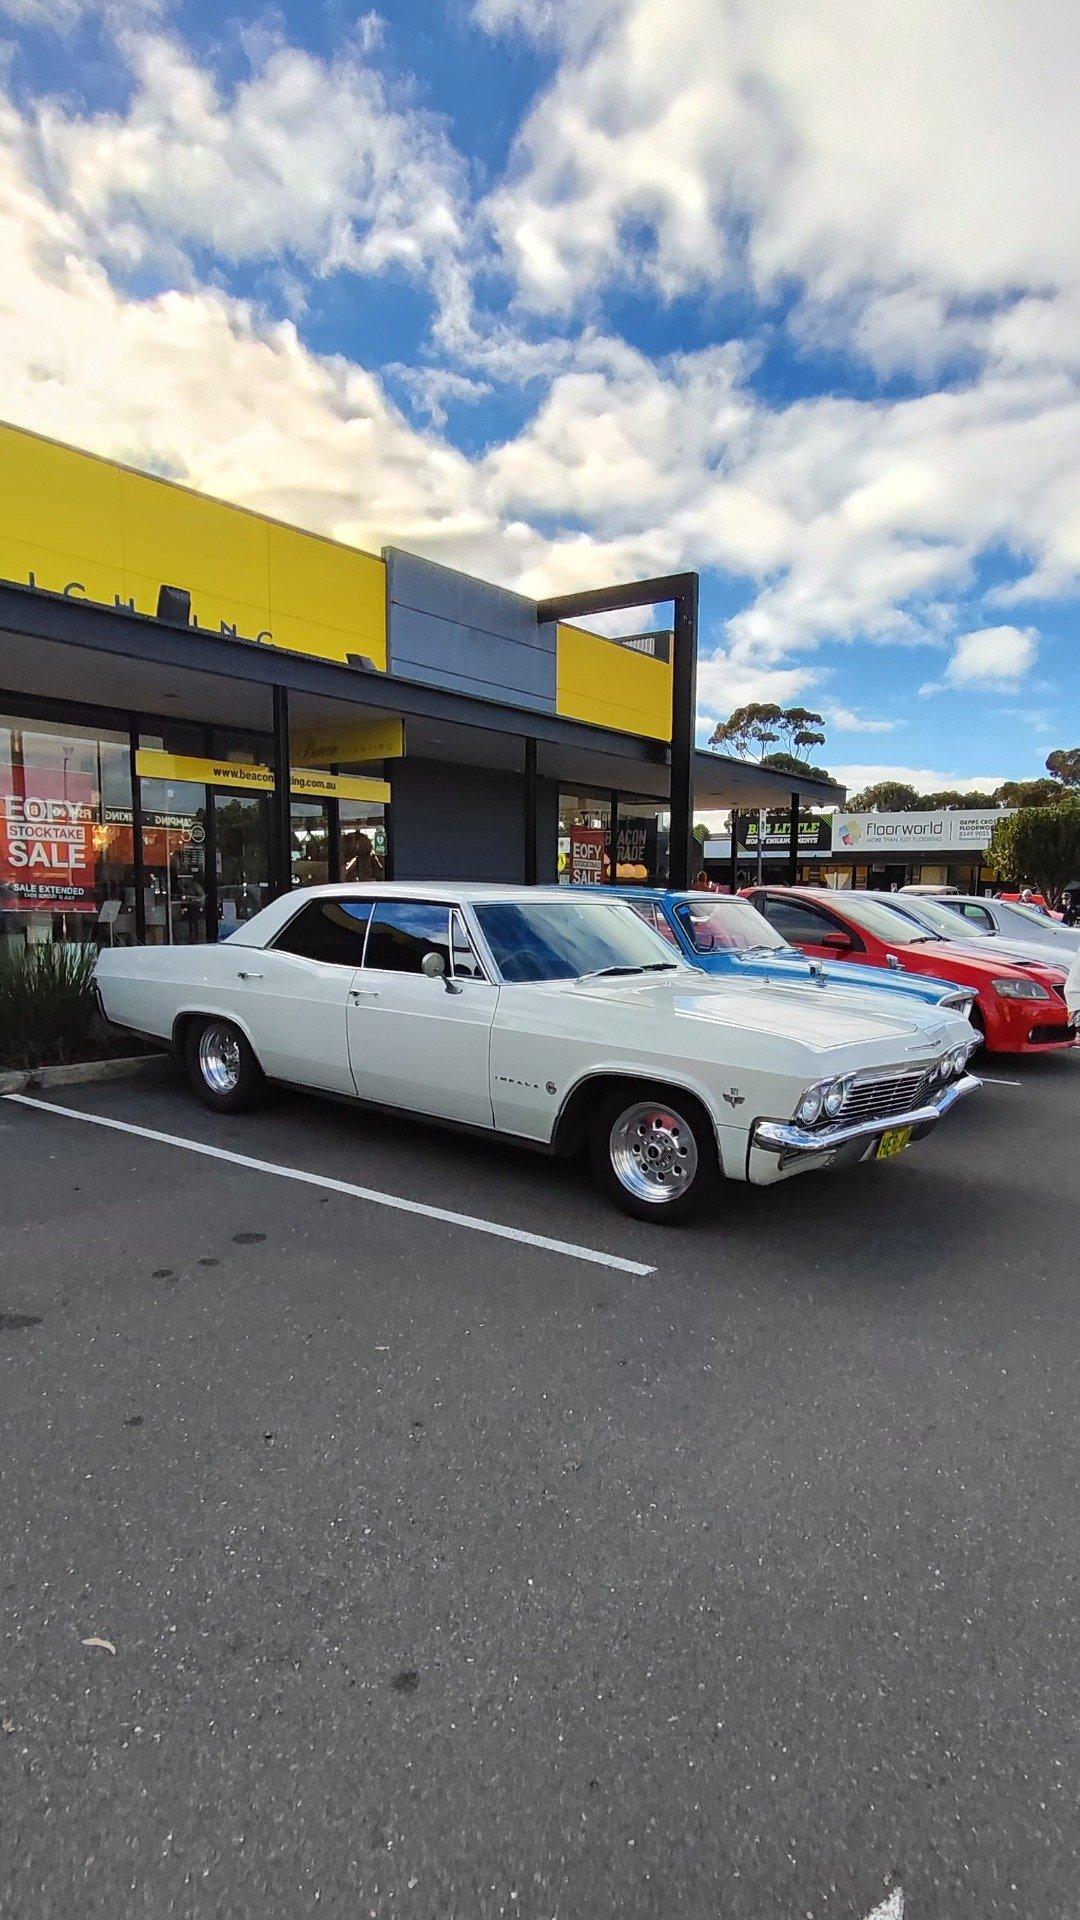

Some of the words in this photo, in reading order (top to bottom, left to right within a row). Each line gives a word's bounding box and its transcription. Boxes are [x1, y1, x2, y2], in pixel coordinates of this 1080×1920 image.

[213, 768, 337, 790] www.beaconing.com.au
[9, 825, 84, 840] STOCKTAKE
[866, 821, 943, 836] floorworld
[8, 841, 86, 868] SALE
[572, 842, 602, 860] EOFY
[572, 869, 602, 885] SALE
[13, 883, 37, 893] SALE
[38, 885, 85, 896] EXTENDED
